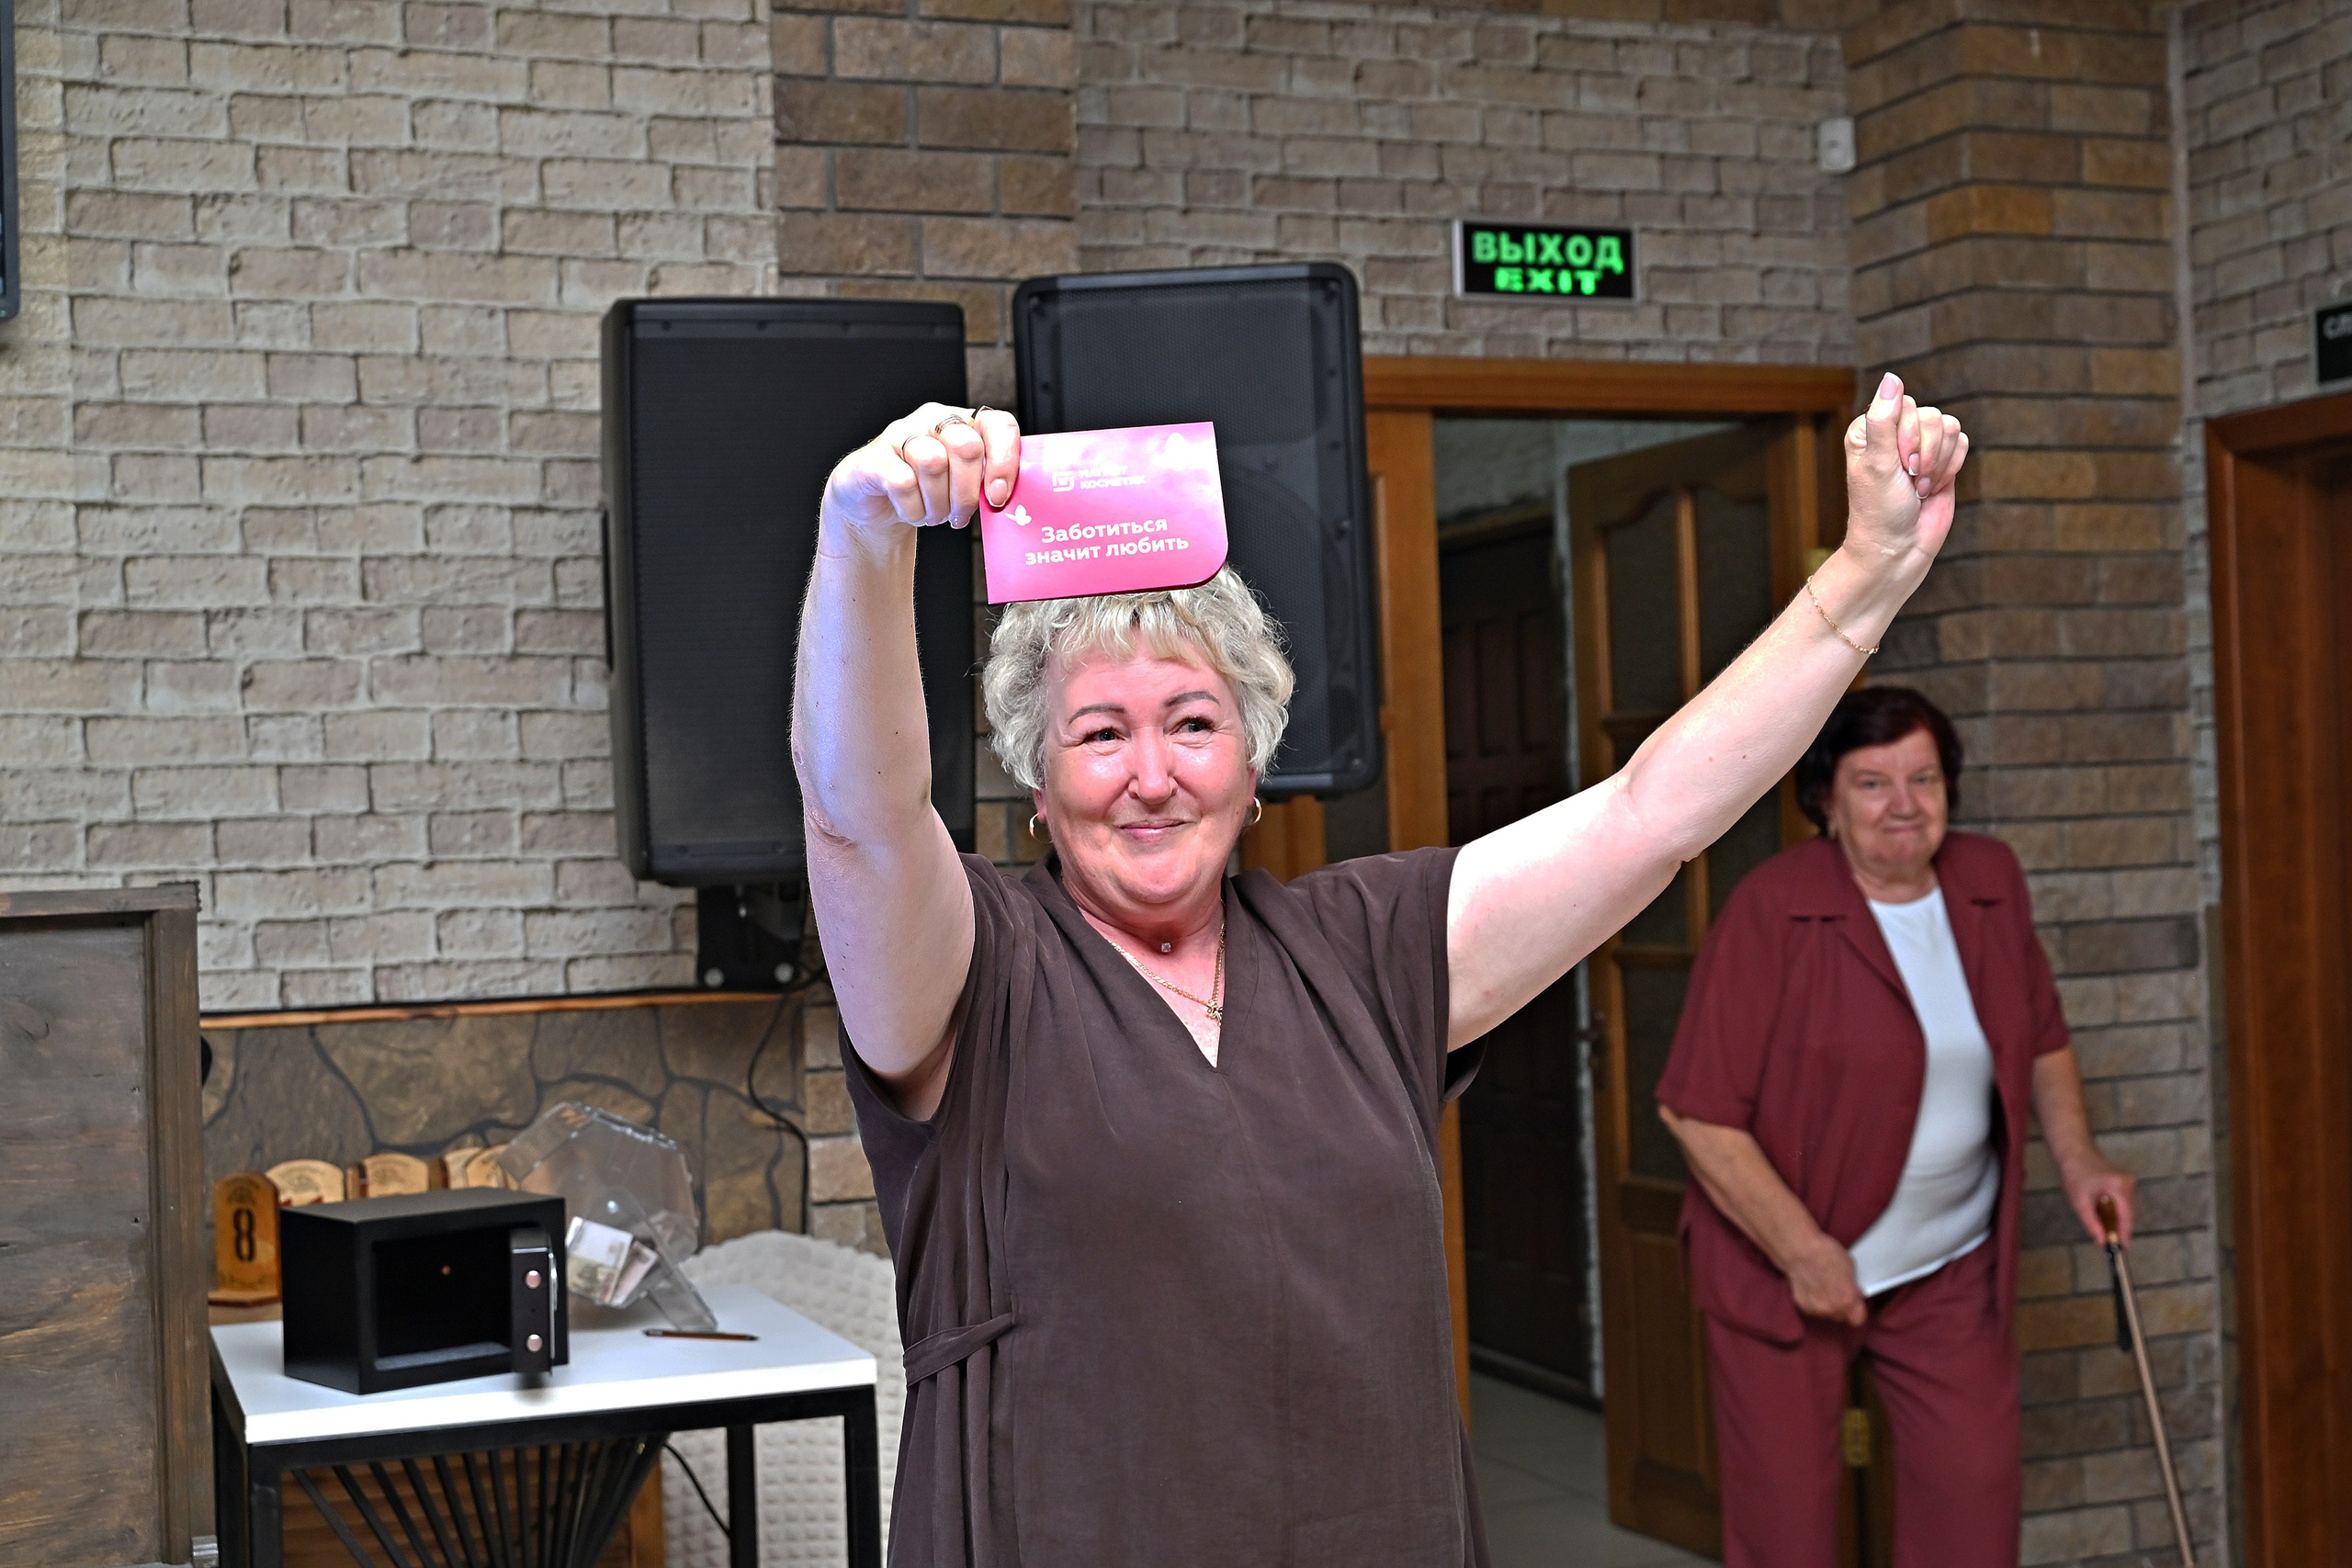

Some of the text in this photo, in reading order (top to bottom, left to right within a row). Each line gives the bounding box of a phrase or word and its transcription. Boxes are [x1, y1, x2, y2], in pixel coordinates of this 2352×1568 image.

[1473, 231, 1624, 275] ВЫХОД
[1494, 266, 1602, 295] EXIT
[1041, 519, 1168, 543] Заботиться
[1024, 536, 1189, 565] значит любить
[233, 1208, 255, 1263] 8
